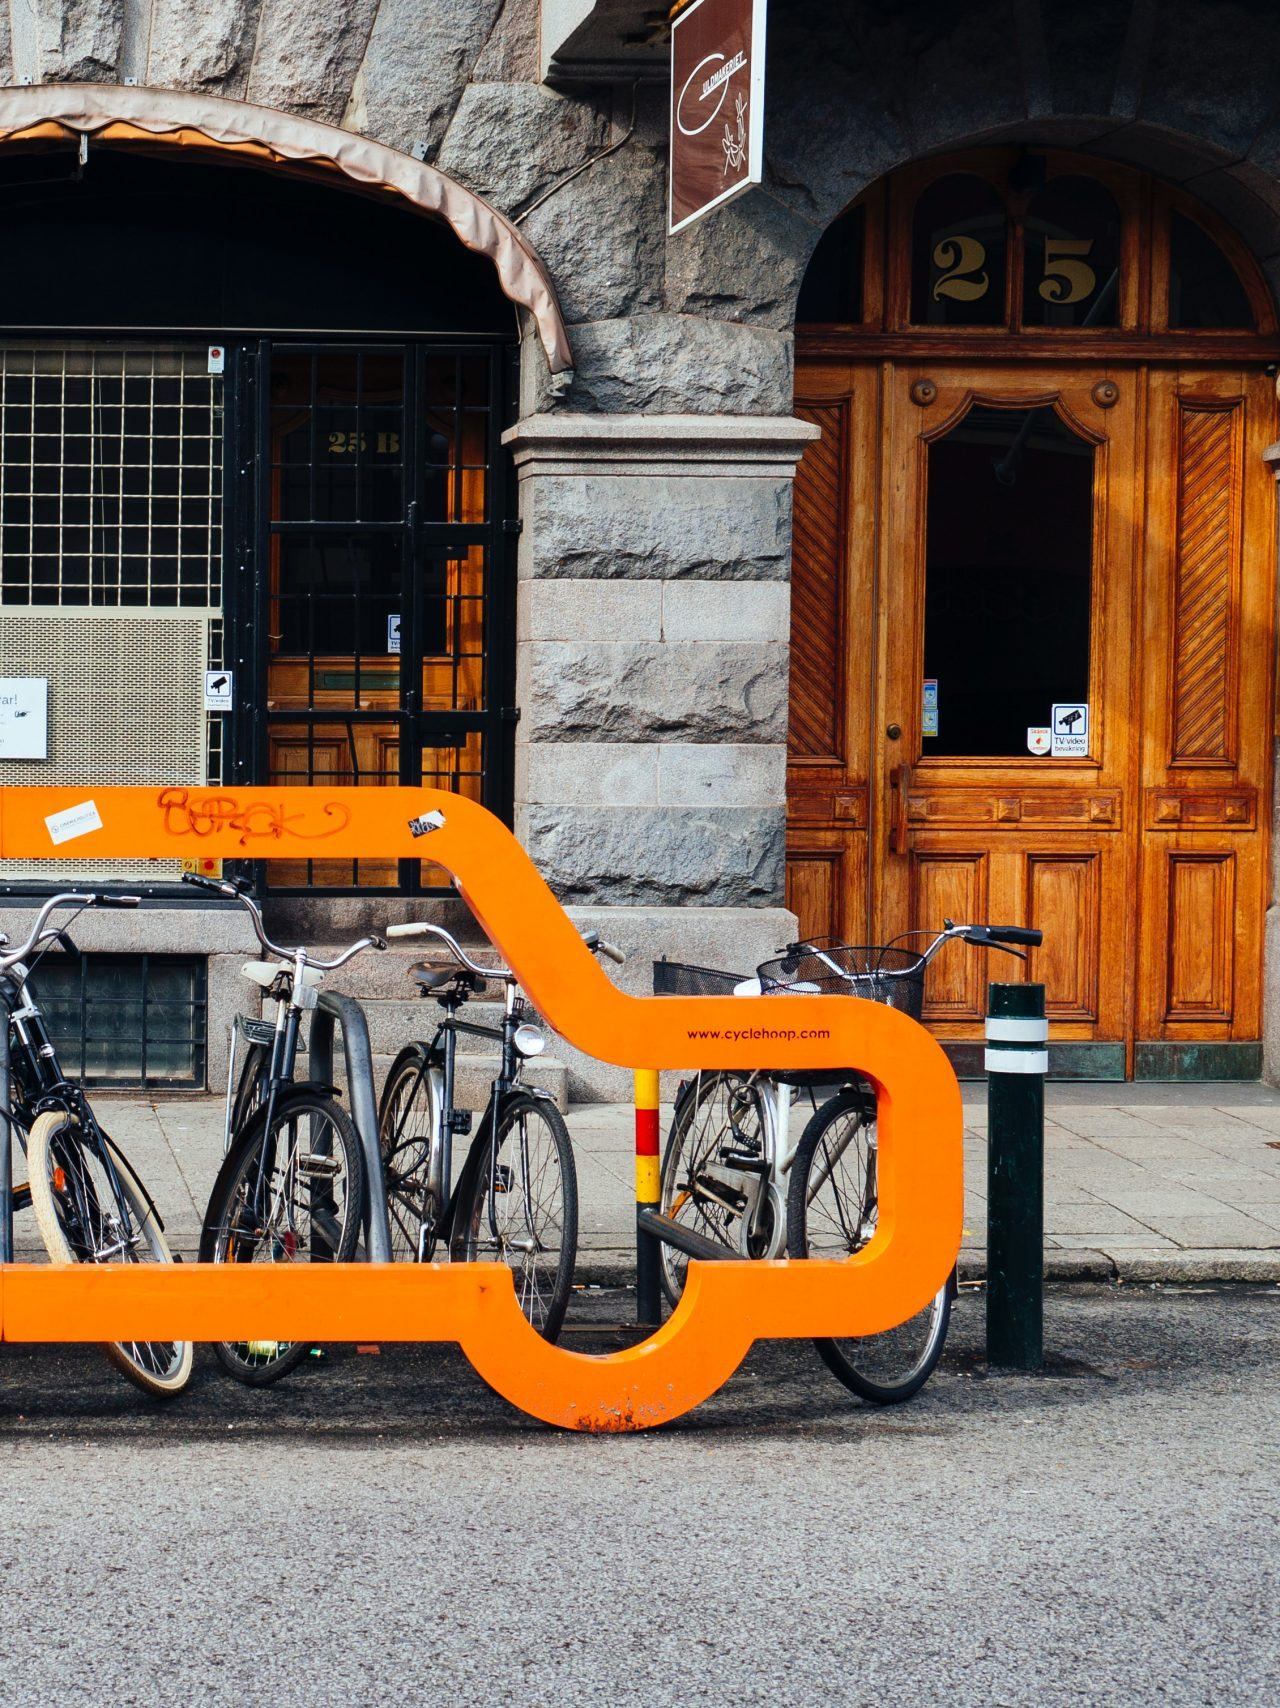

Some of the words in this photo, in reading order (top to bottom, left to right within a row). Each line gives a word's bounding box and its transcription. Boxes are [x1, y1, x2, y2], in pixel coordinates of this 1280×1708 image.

[933, 235, 1096, 303] 25
[328, 431, 367, 453] 25
[376, 432, 400, 453] B
[687, 1028, 830, 1041] www.cyclehoop.com
